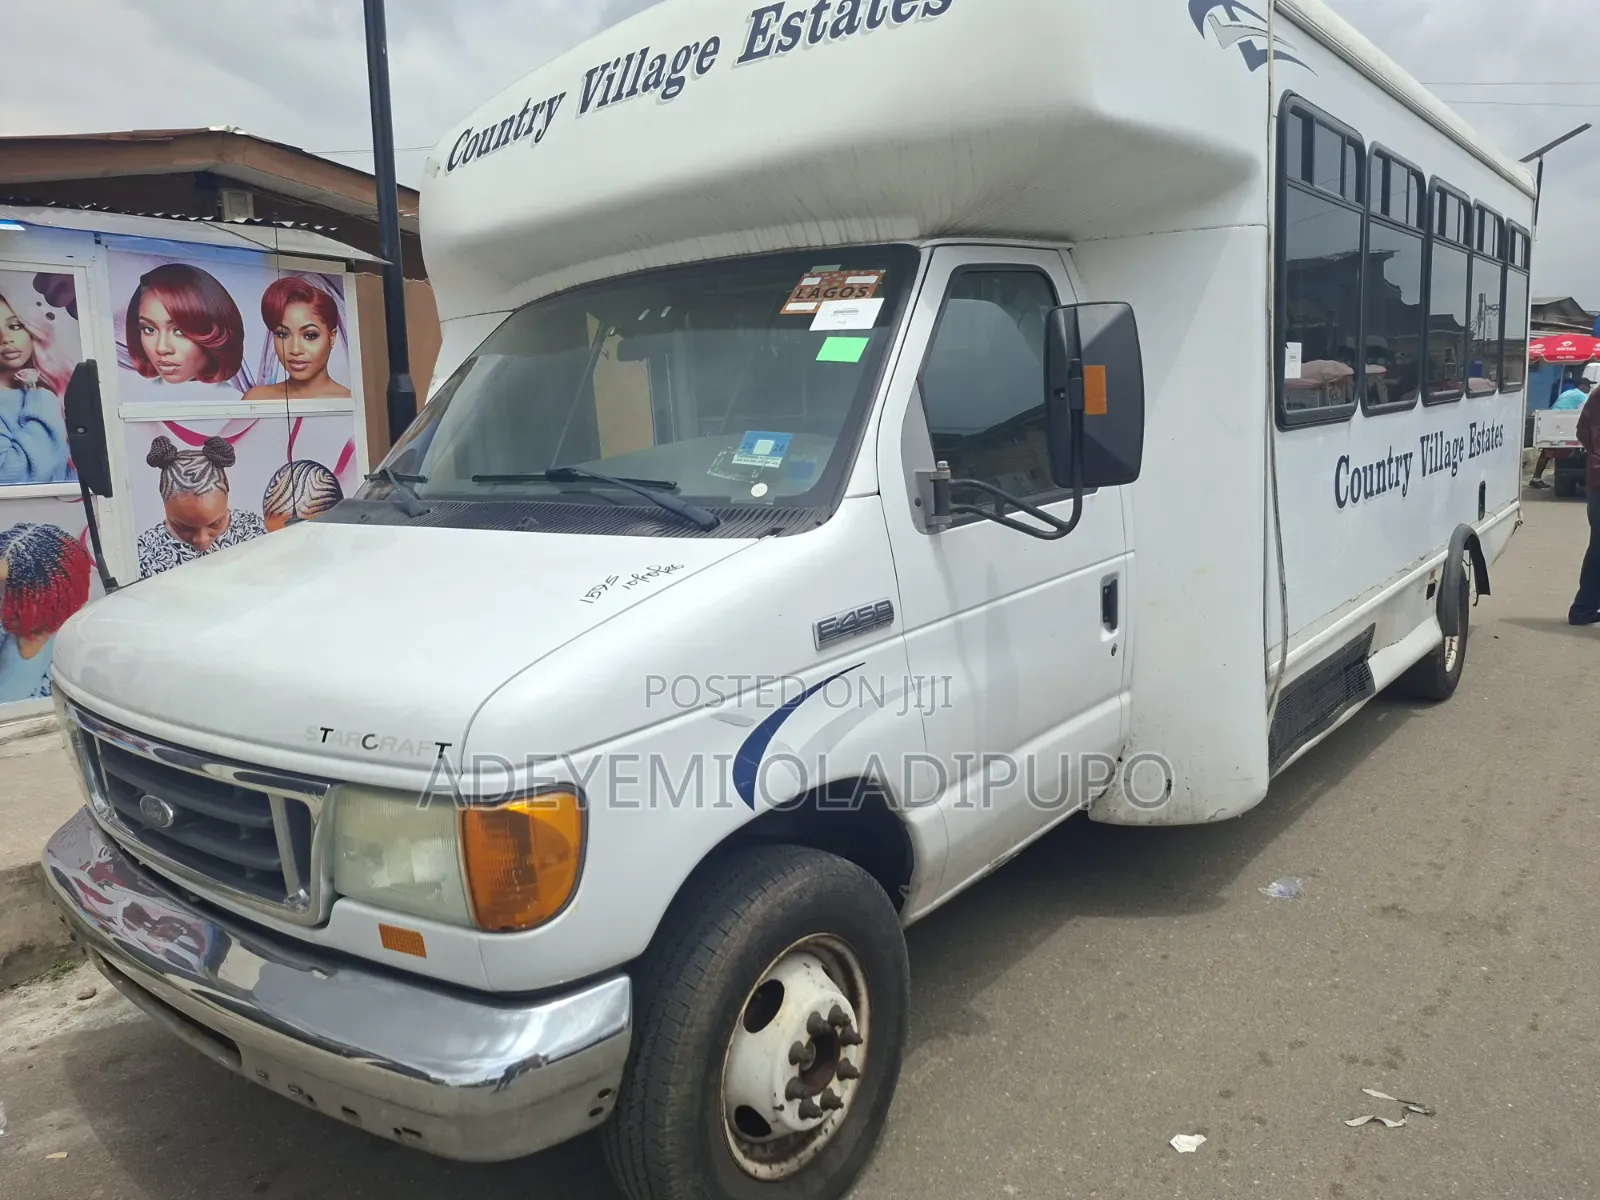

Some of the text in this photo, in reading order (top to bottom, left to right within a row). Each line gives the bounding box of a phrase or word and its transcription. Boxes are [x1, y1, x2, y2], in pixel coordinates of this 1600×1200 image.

[447, 91, 567, 172] Country
[578, 35, 721, 115] Village
[795, 286, 869, 299] LAGOS
[1335, 419, 1504, 509] Country Village Estates
